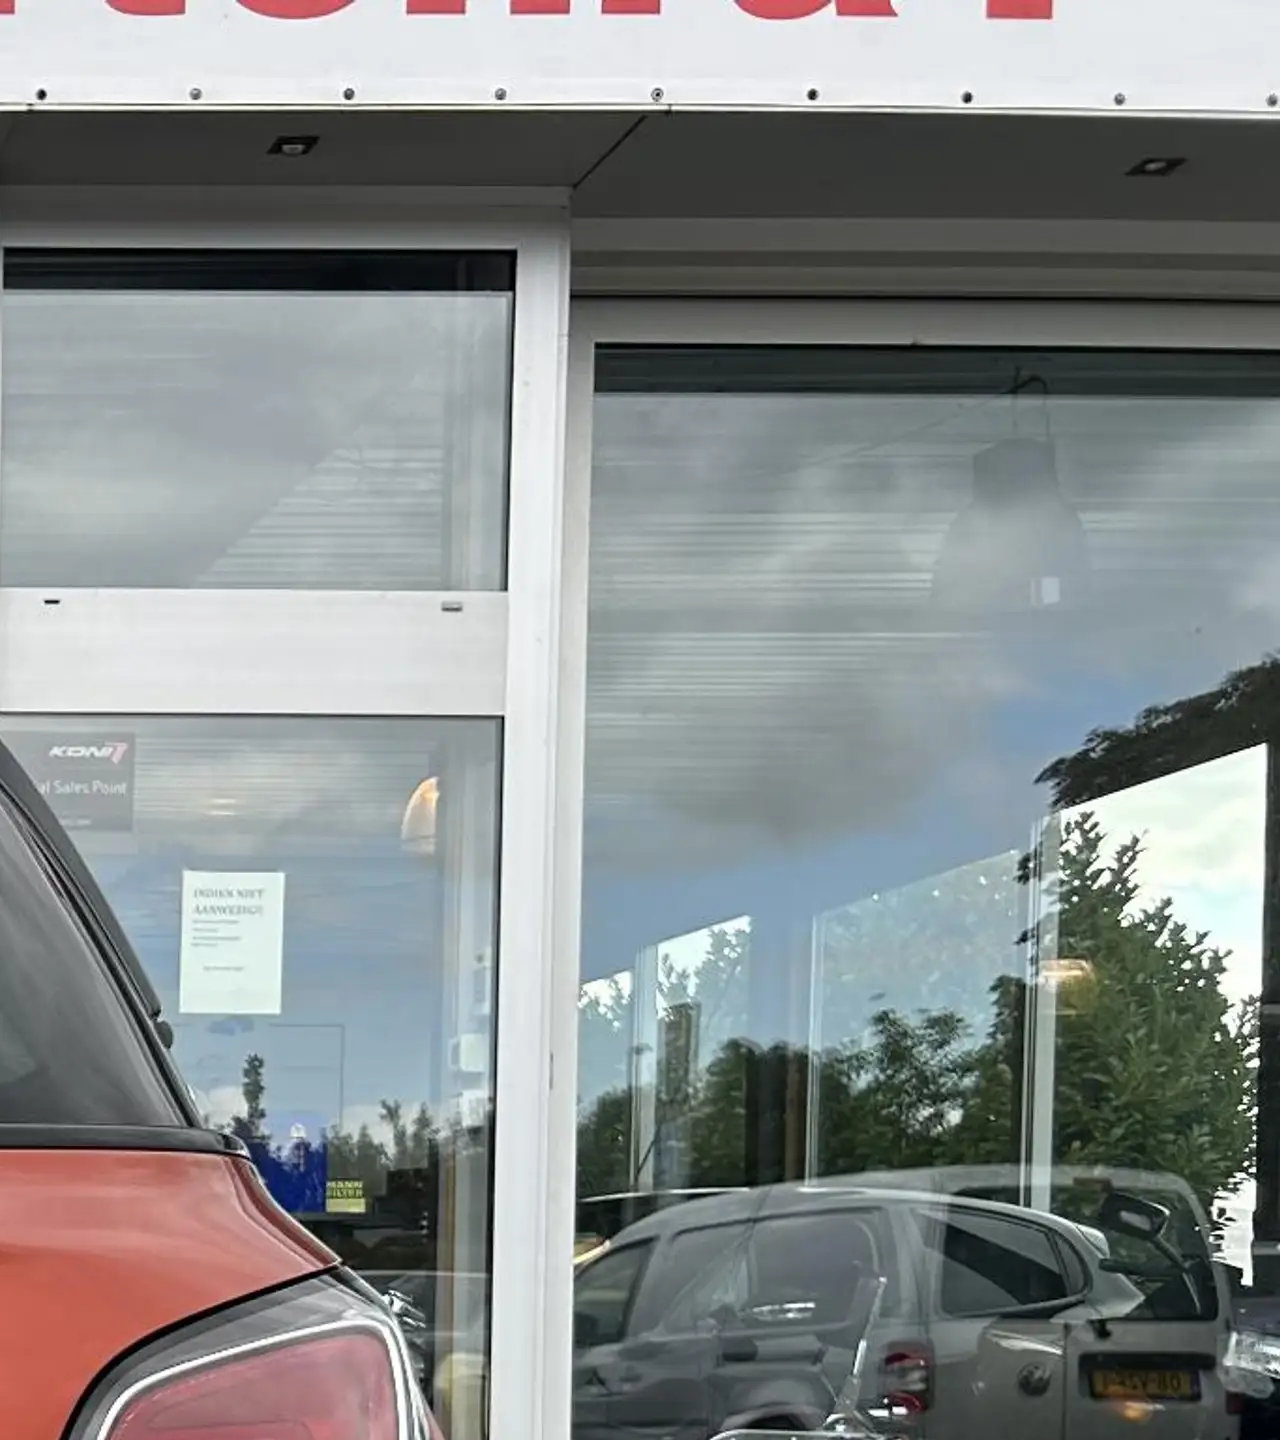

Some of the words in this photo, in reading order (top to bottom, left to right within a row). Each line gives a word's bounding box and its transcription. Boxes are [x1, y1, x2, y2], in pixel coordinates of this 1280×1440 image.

[48, 744, 117, 759] KONI
[53, 779, 91, 795] Sales
[92, 779, 128, 796] Point
[326, 1180, 364, 1188] MANN
